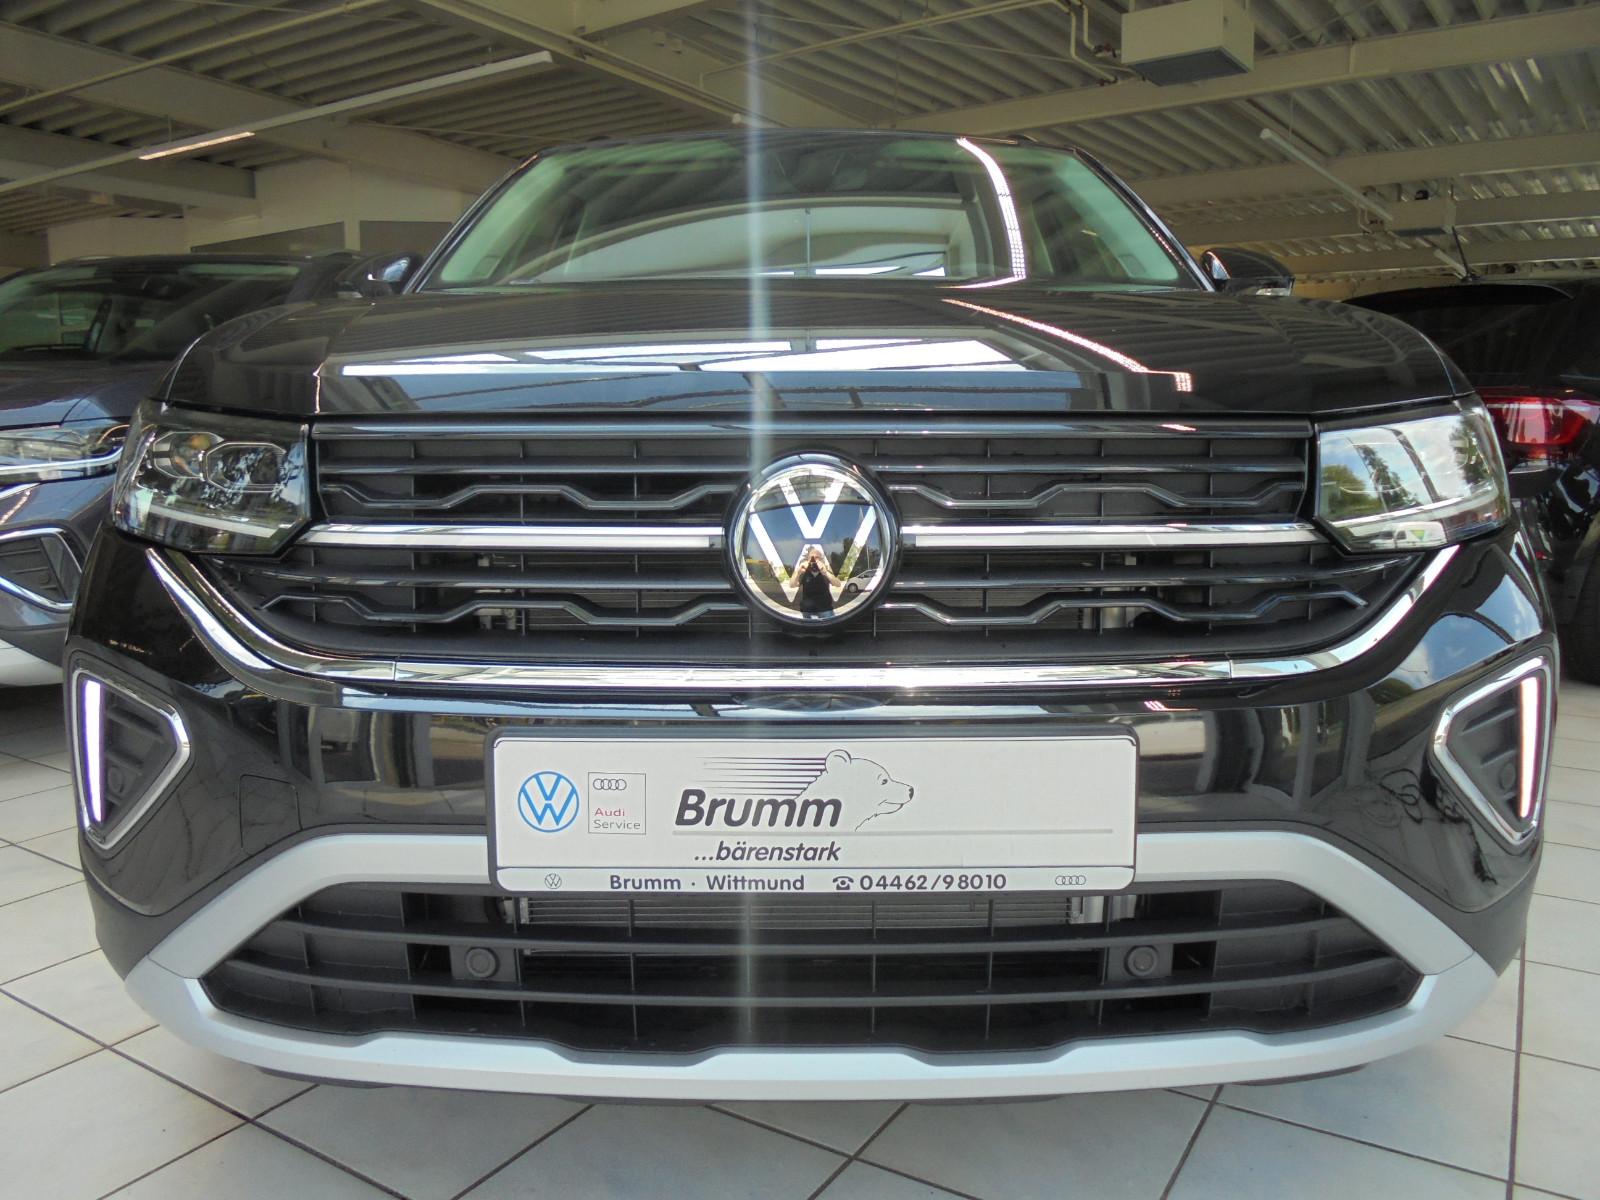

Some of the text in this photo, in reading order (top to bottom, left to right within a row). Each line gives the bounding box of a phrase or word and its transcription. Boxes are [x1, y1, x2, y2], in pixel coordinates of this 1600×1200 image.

[519, 772, 578, 831] VW
[674, 788, 842, 828] Brumm
[594, 806, 626, 818] Audi
[593, 818, 641, 831] Service
[609, 873, 1007, 891] Brumm Wittmund 04462/98010
